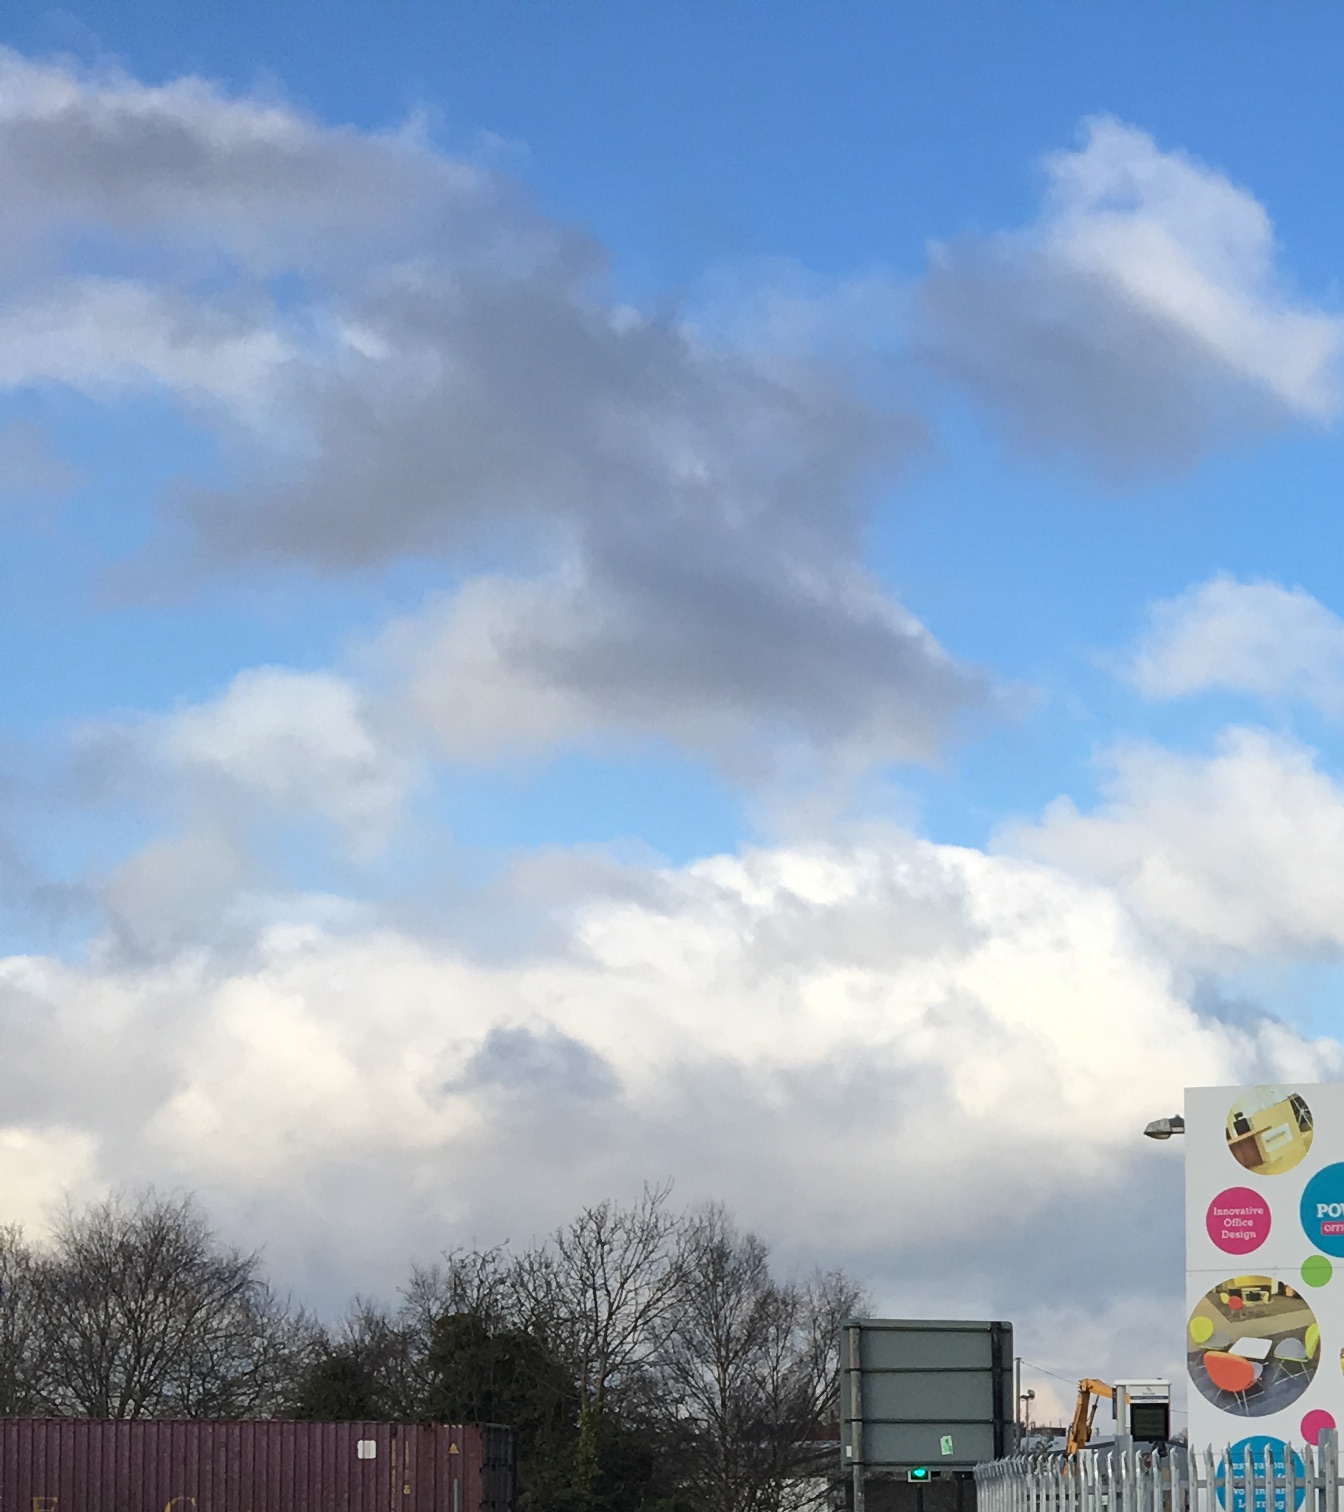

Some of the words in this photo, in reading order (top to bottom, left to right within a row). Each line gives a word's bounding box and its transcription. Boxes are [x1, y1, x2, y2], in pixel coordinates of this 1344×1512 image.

[1213, 1206, 1264, 1216] Innovative
[1223, 1218, 1254, 1228] Office
[1221, 1229, 1257, 1240] Design
